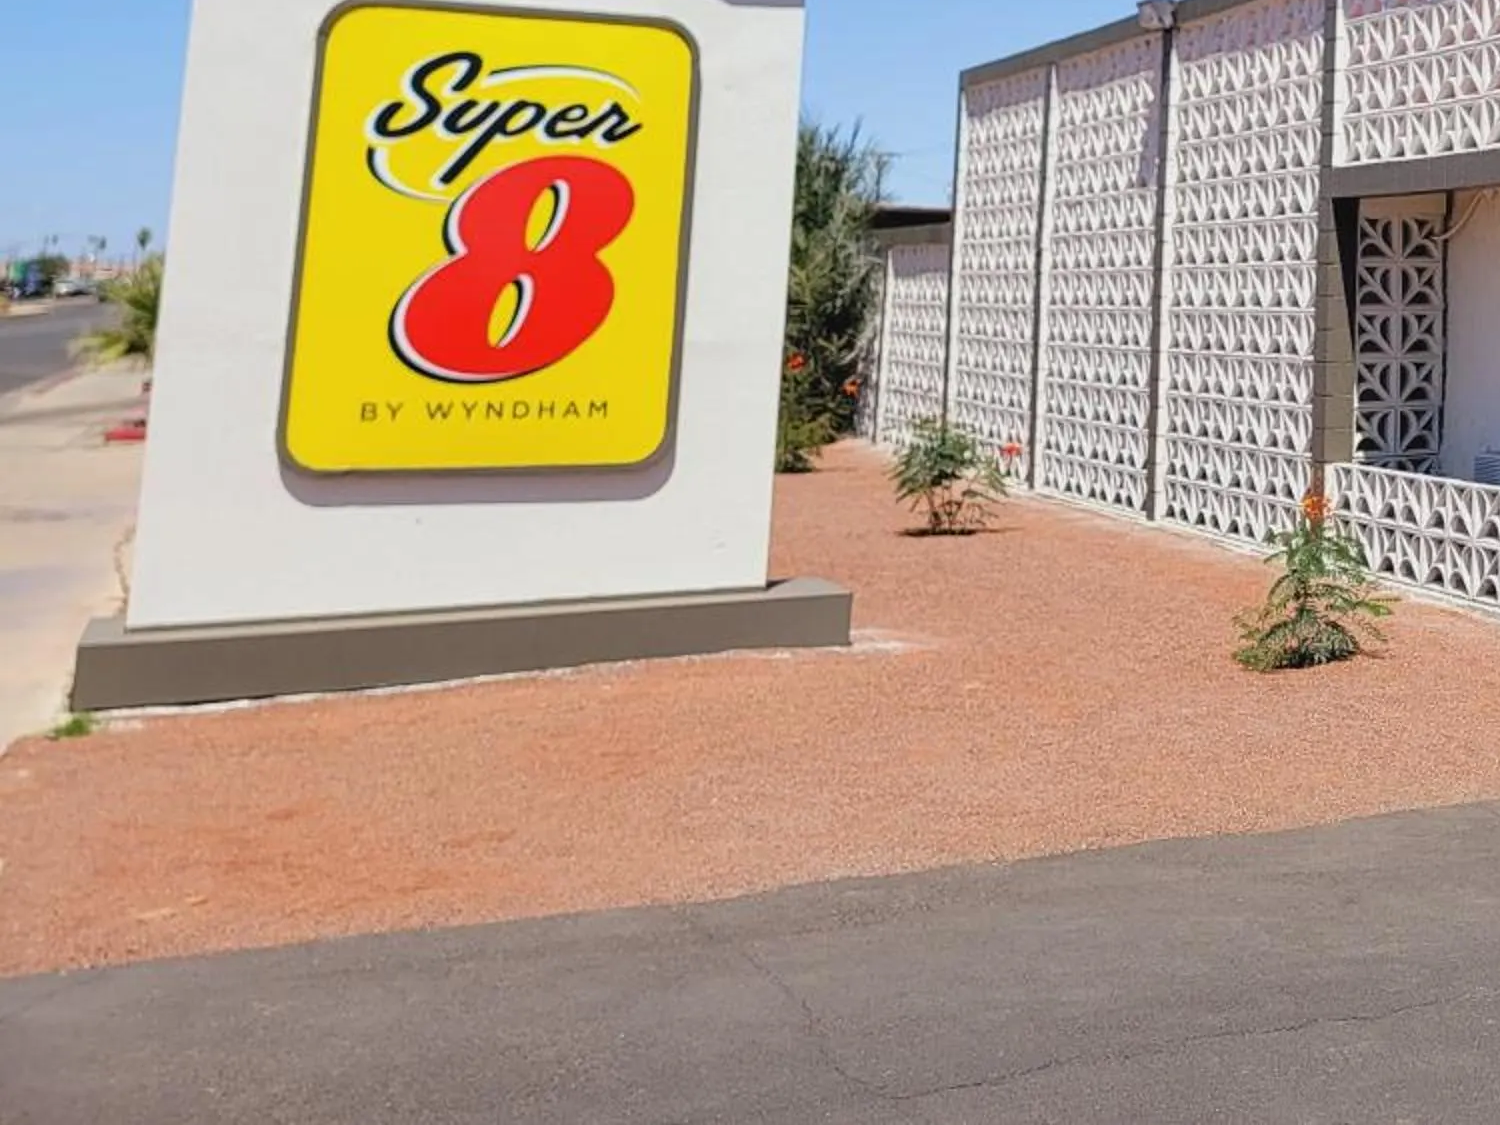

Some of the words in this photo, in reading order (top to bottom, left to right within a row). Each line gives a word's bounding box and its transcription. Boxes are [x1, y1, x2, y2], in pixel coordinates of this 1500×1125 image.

[371, 51, 643, 185] Super
[388, 155, 635, 385] 8
[360, 401, 403, 422] BY
[426, 400, 609, 421] WYNDHAM
